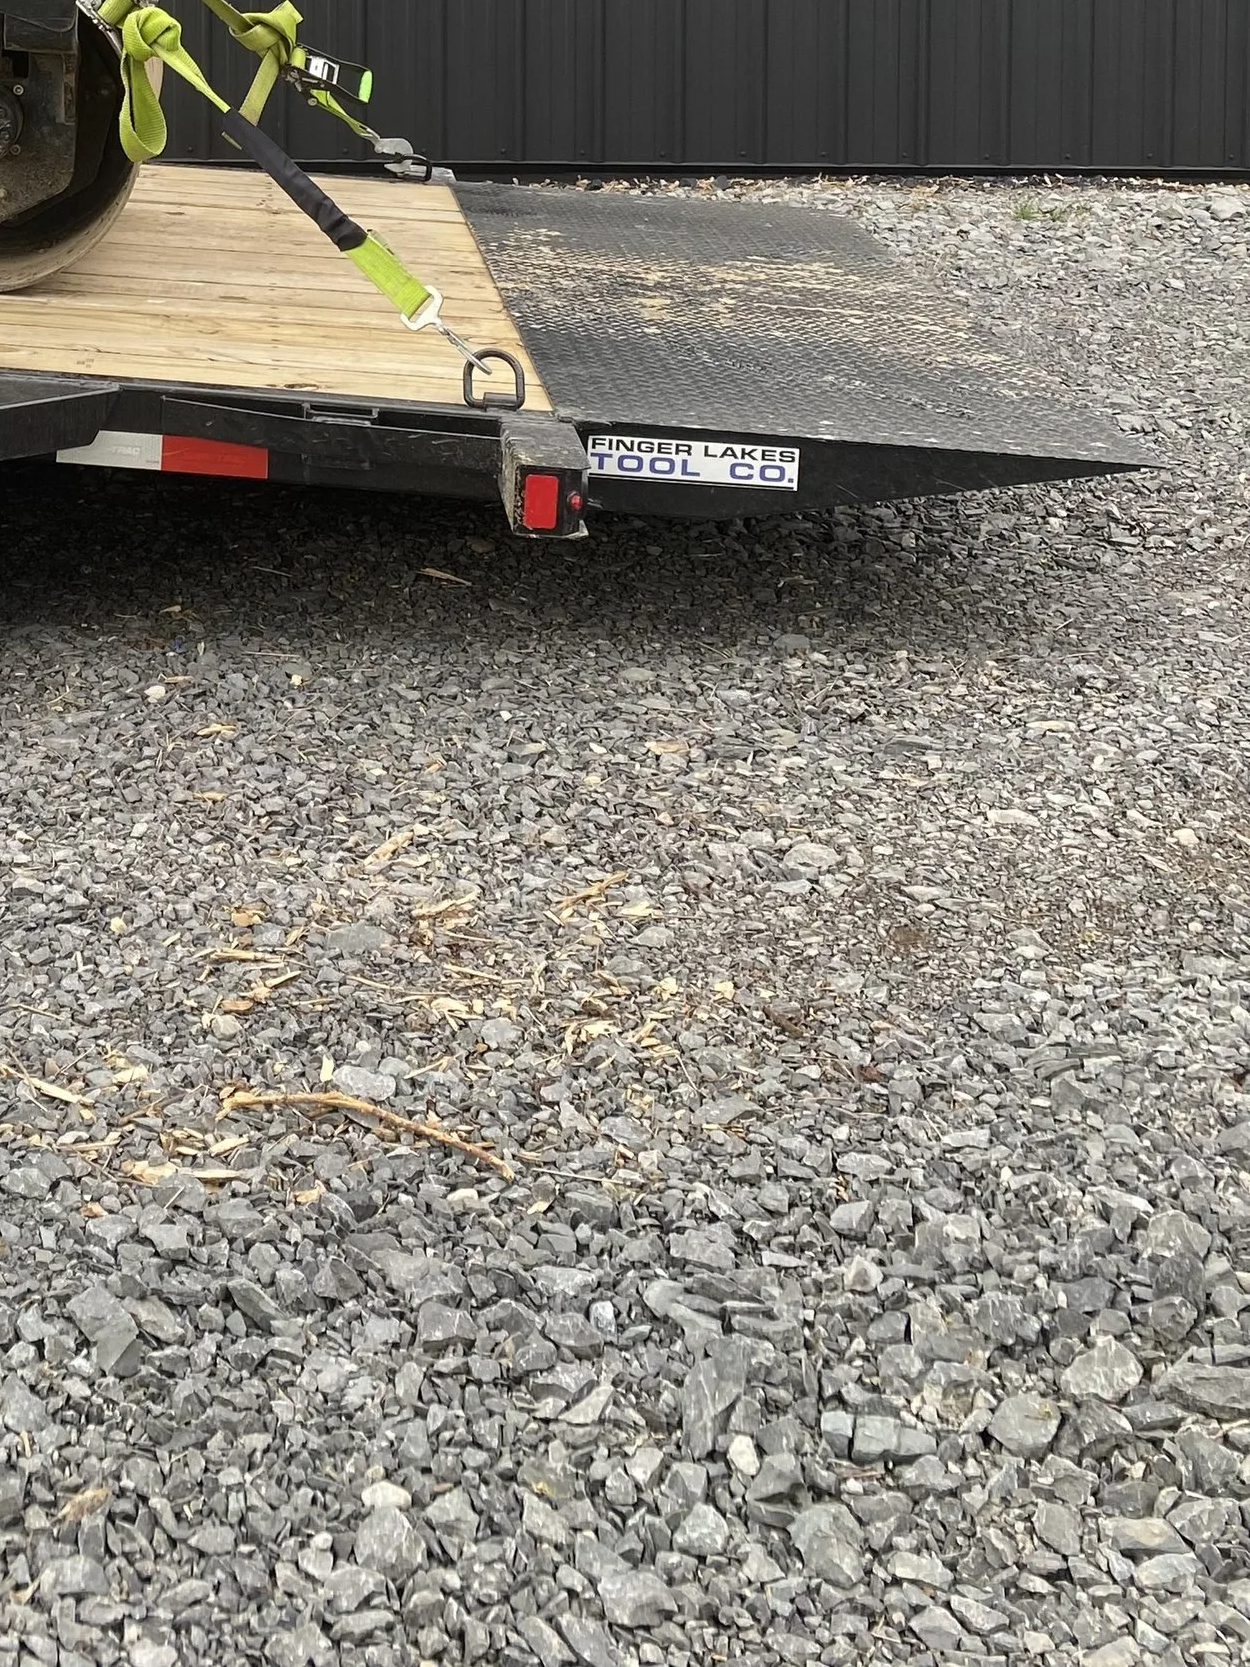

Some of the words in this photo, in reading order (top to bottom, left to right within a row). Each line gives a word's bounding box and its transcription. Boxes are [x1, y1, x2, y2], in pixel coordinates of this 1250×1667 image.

[591, 437, 693, 456] FINGER
[704, 445, 796, 463] LAKES
[590, 452, 701, 477] TOOL
[729, 462, 794, 484] CO.
